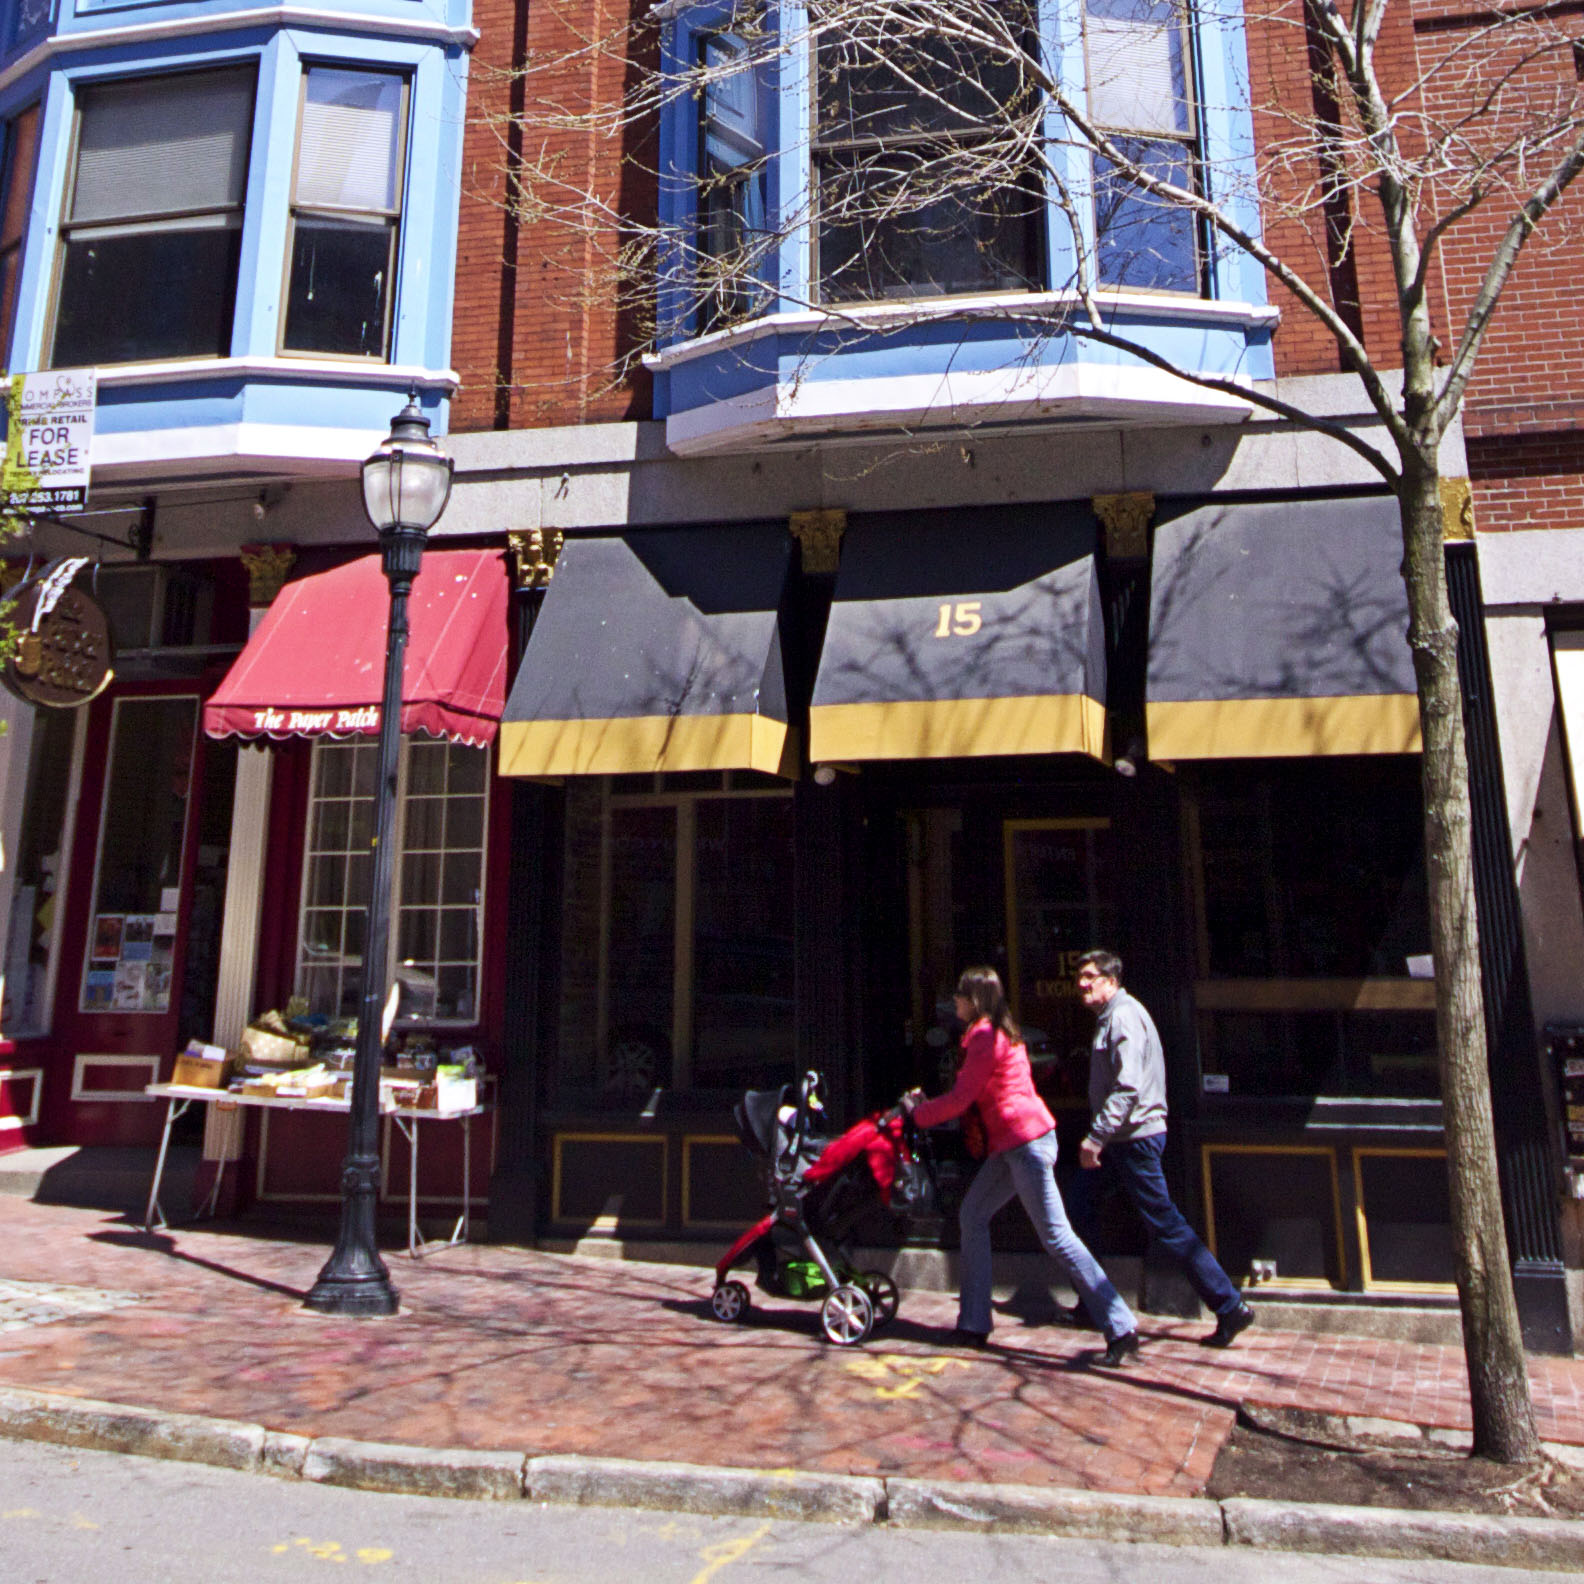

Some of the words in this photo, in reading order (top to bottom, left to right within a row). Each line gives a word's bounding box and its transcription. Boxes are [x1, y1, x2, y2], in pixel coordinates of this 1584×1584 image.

[51, 414, 87, 424] RETAIL
[29, 427, 70, 446] FOR
[16, 447, 79, 468] LEASE
[935, 601, 983, 638] 15
[252, 706, 285, 730] The
[287, 712, 334, 735] Paper
[335, 705, 380, 729] Patch
